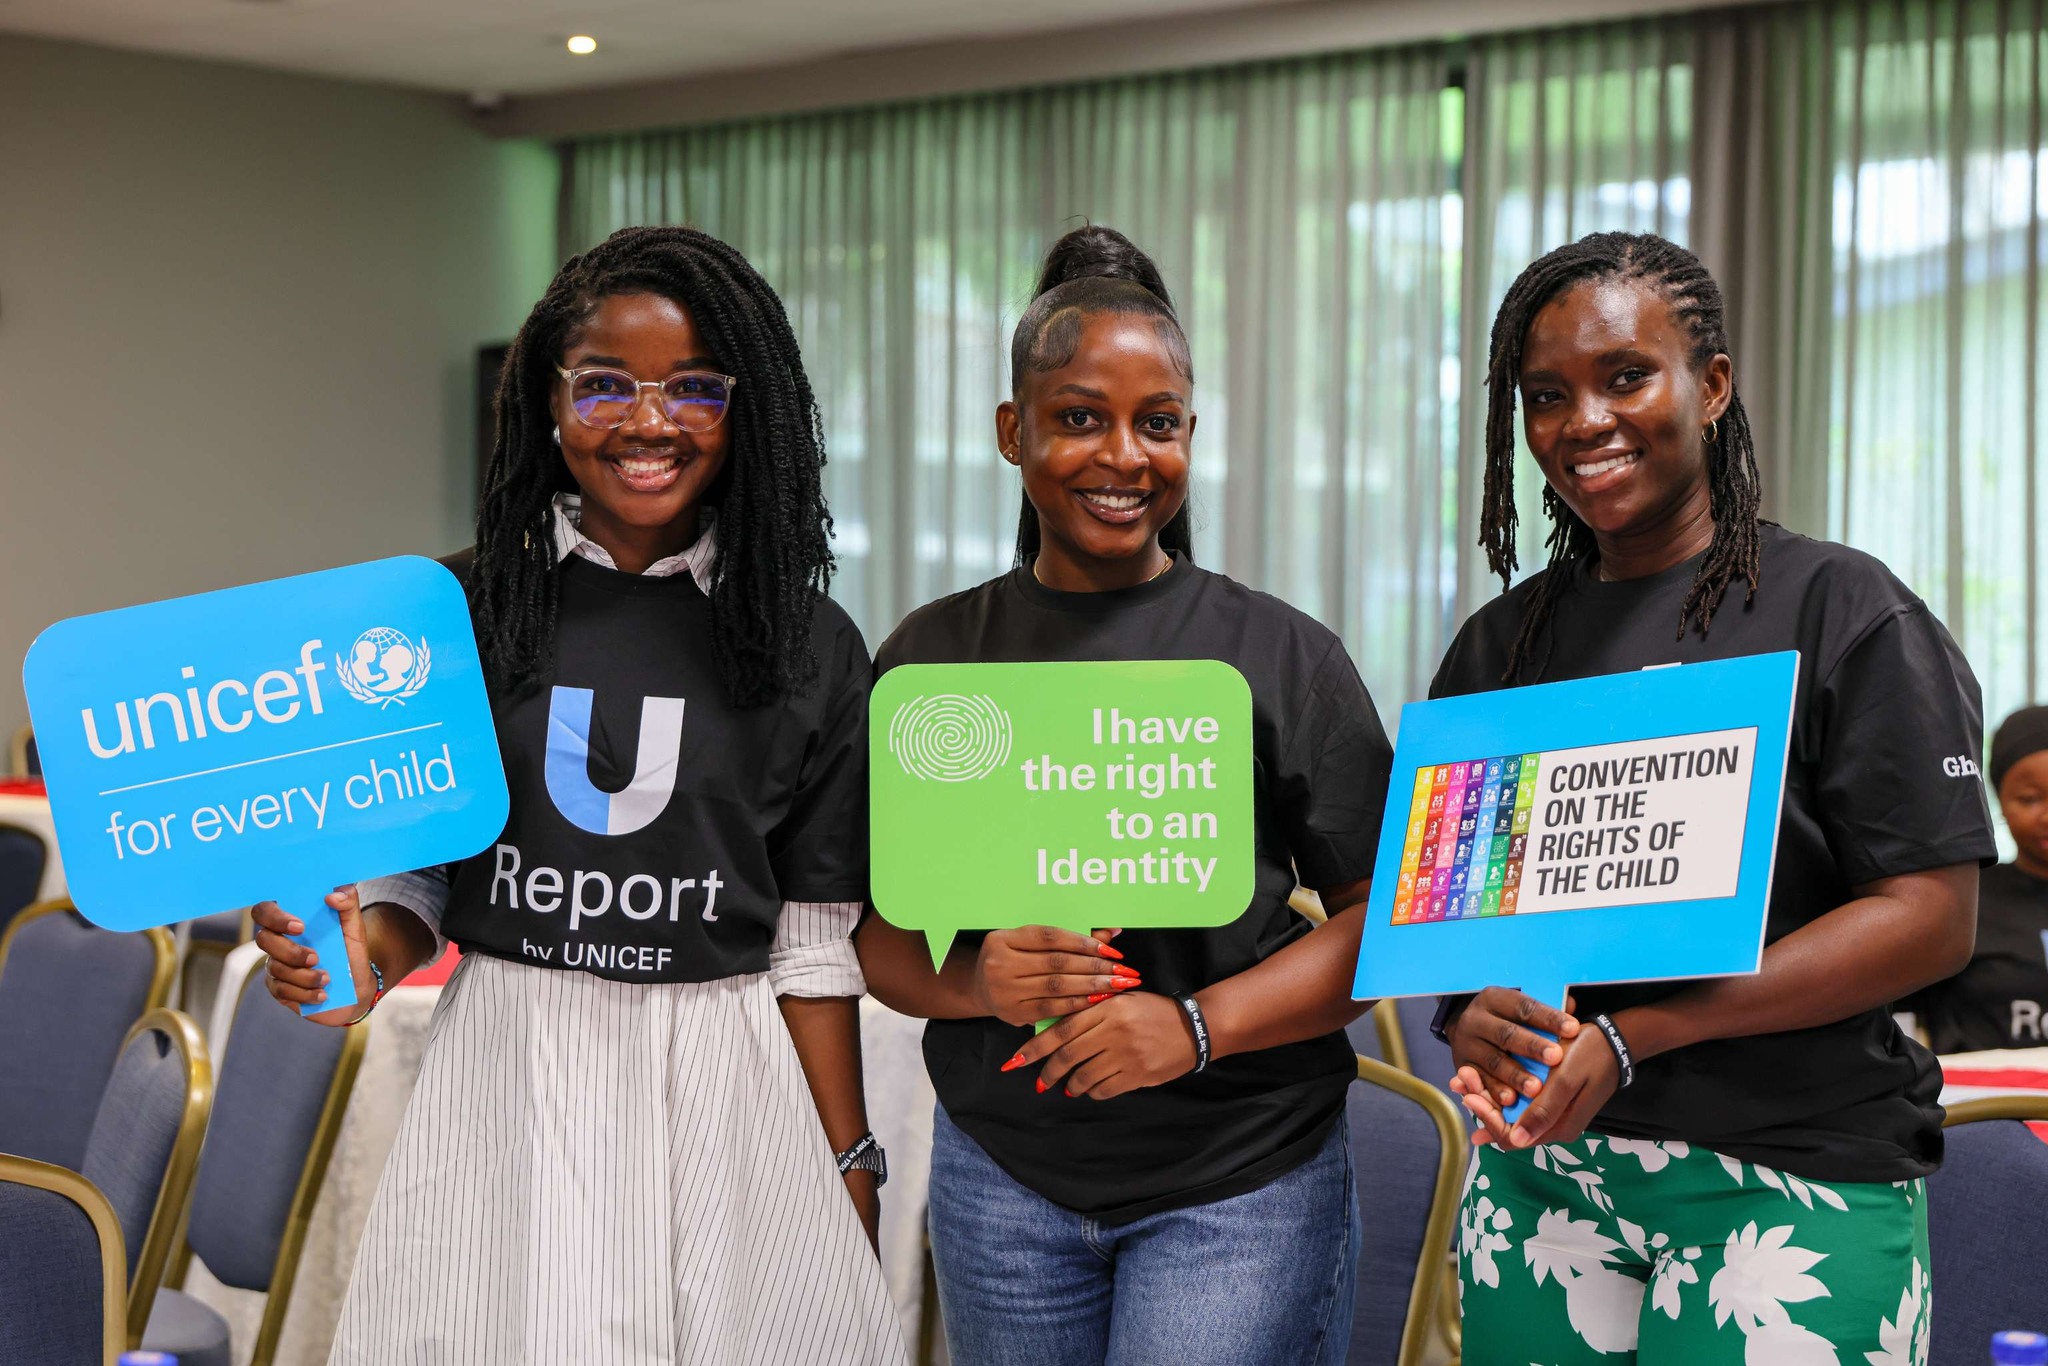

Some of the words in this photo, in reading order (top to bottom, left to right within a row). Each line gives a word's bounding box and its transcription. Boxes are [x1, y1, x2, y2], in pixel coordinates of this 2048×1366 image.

[81, 639, 327, 760] unicef
[1092, 707, 1103, 745] I
[1110, 707, 1220, 744] have
[544, 686, 686, 836] U
[1020, 754, 1097, 791] the
[1106, 752, 1217, 799] right
[1550, 745, 1739, 793] CONVENTION
[105, 810, 177, 860] for
[191, 781, 330, 842] every
[344, 743, 457, 810] child
[1105, 806, 1154, 840] to
[1162, 812, 1218, 839] an
[1545, 796, 1586, 828] ON
[1594, 789, 1648, 822] THE
[1538, 824, 1641, 862] RIGHTS
[1648, 820, 1686, 851] OF
[489, 843, 725, 931] Report
[1037, 847, 1218, 893] Identity
[1536, 863, 1589, 896] THE
[1596, 856, 1680, 891] CHILD
[563, 941, 673, 971] UNICEF
